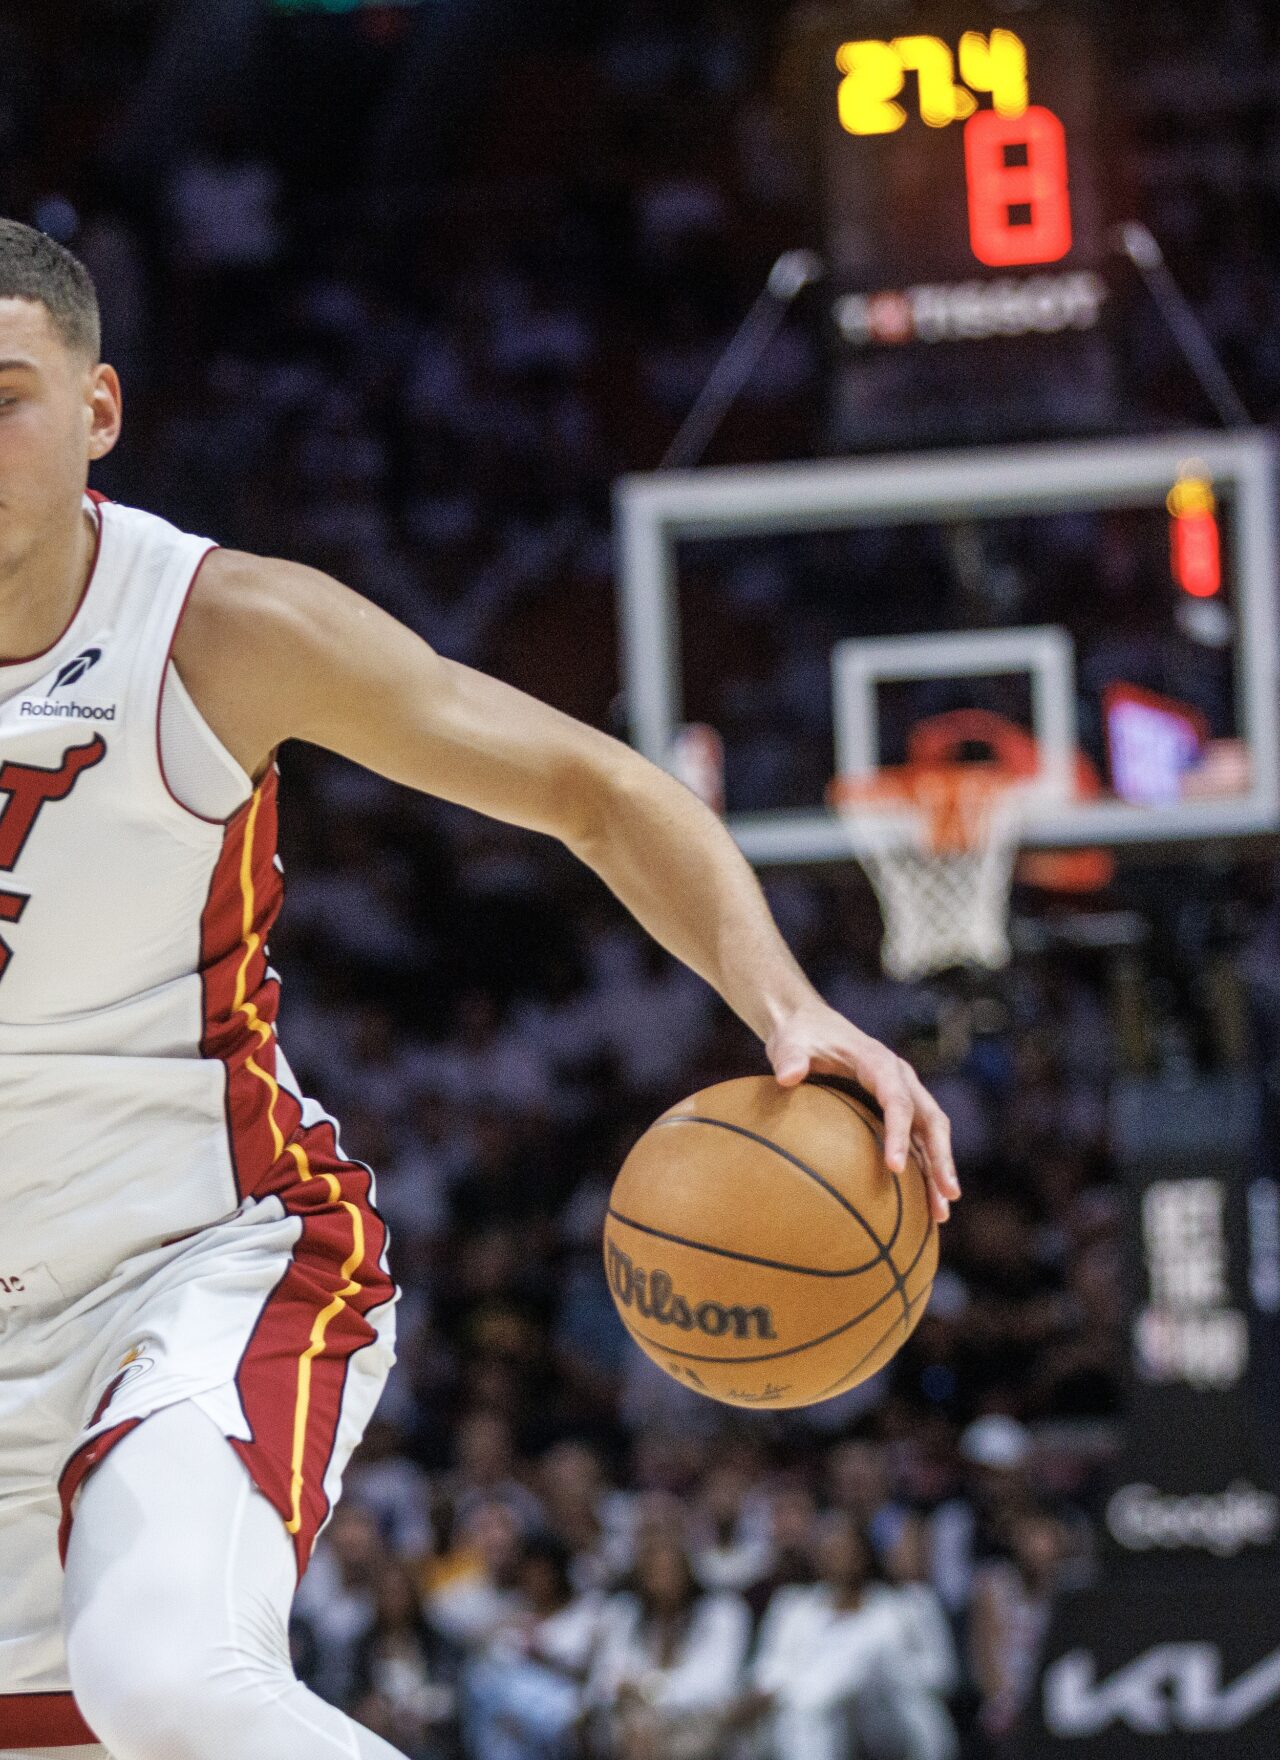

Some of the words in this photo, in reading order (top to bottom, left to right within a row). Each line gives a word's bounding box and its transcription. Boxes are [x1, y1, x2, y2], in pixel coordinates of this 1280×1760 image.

[836, 28, 1029, 136] 27.4
[963, 104, 1073, 267] 8
[19, 701, 116, 721] Robinhood
[608, 1236, 778, 1340] Wilson
